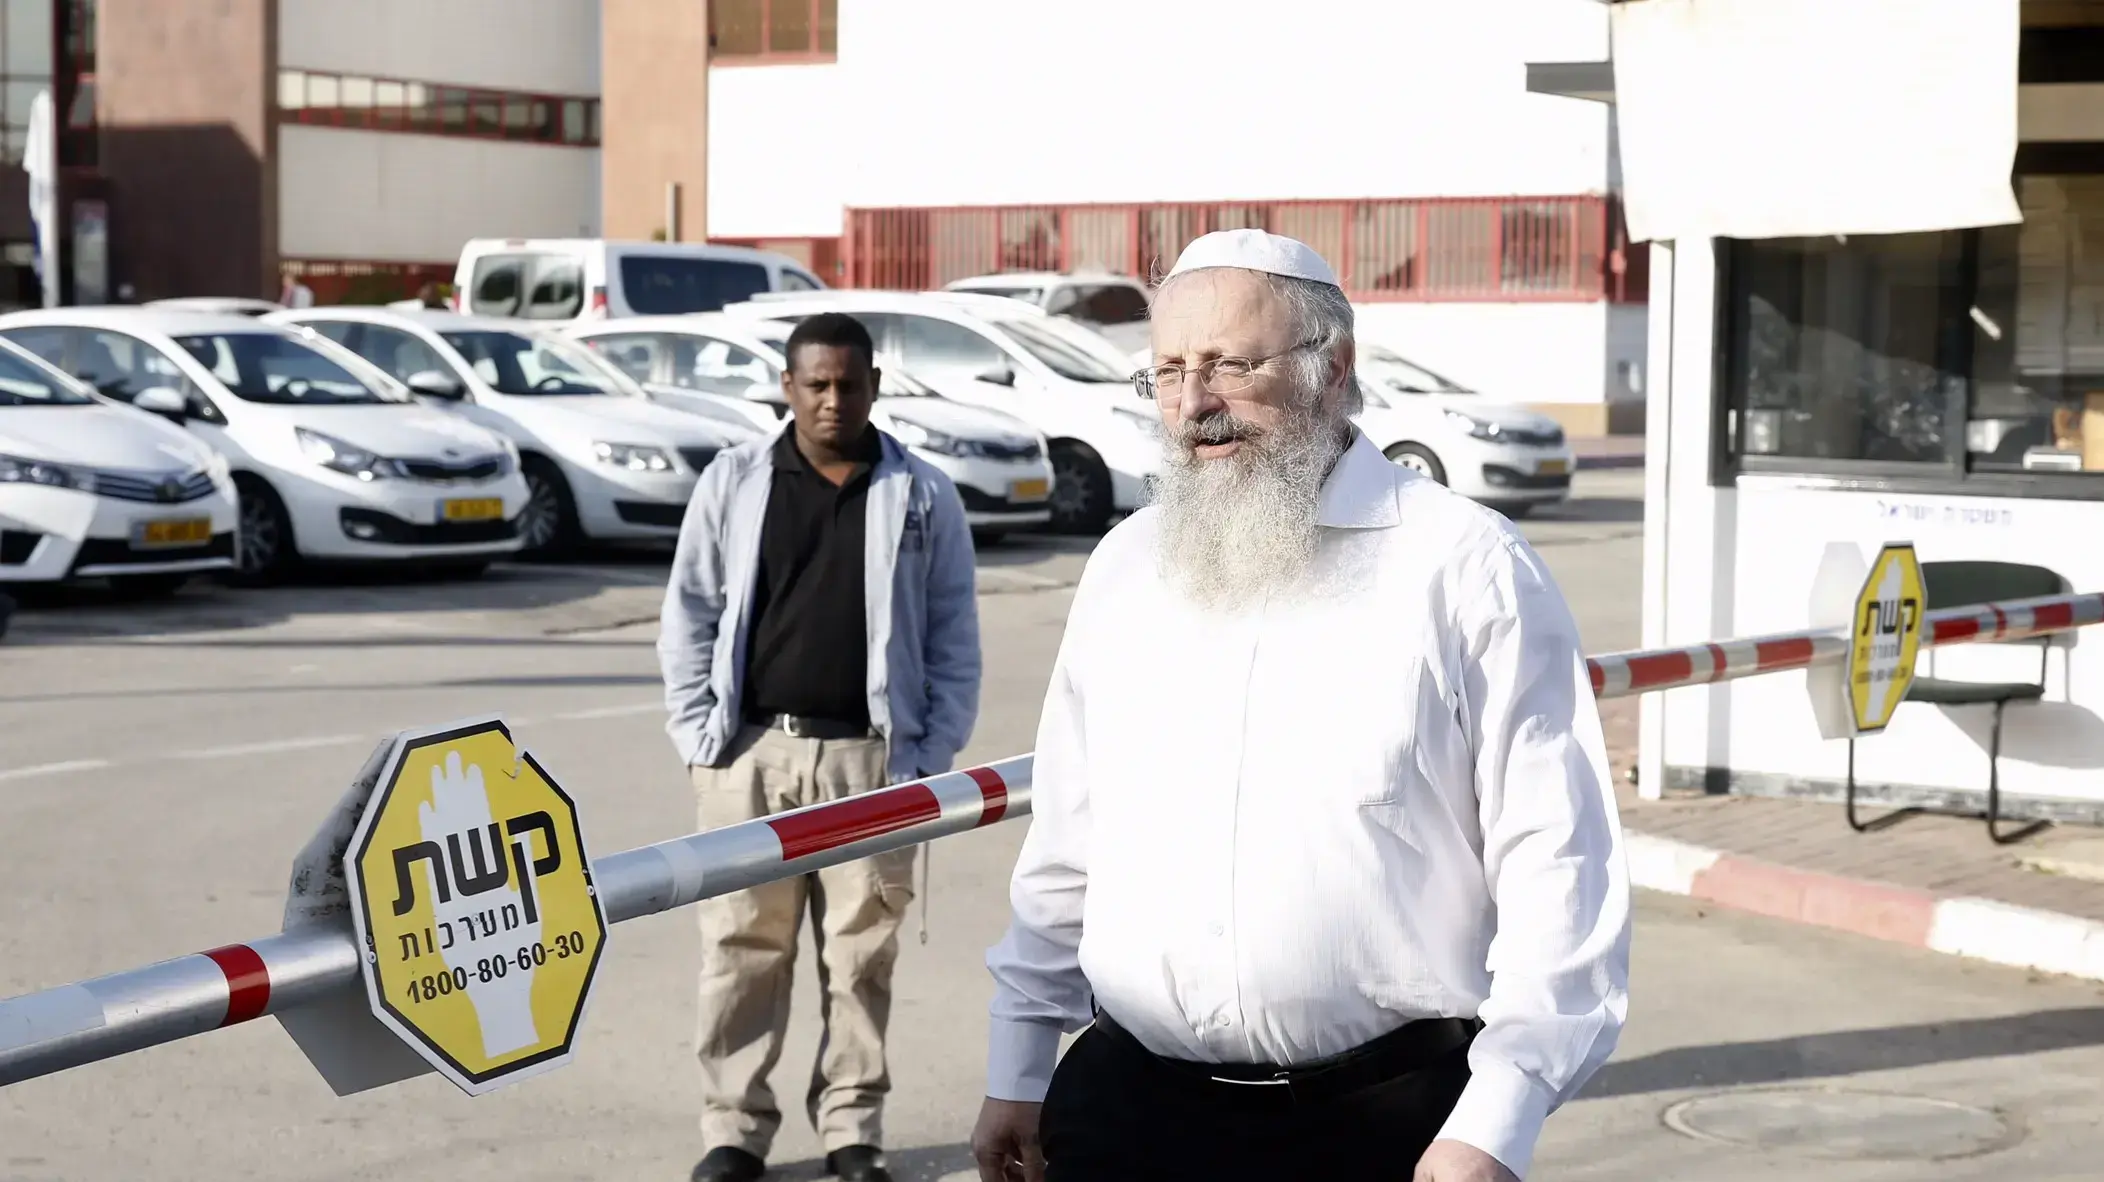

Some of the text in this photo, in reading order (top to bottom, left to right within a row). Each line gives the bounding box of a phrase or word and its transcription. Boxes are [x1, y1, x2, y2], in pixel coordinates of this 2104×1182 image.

[1861, 598, 1917, 657] קשת
[391, 810, 561, 925] קשת
[398, 903, 520, 961] מערכות
[406, 930, 585, 1004] 1800-80-60-30
